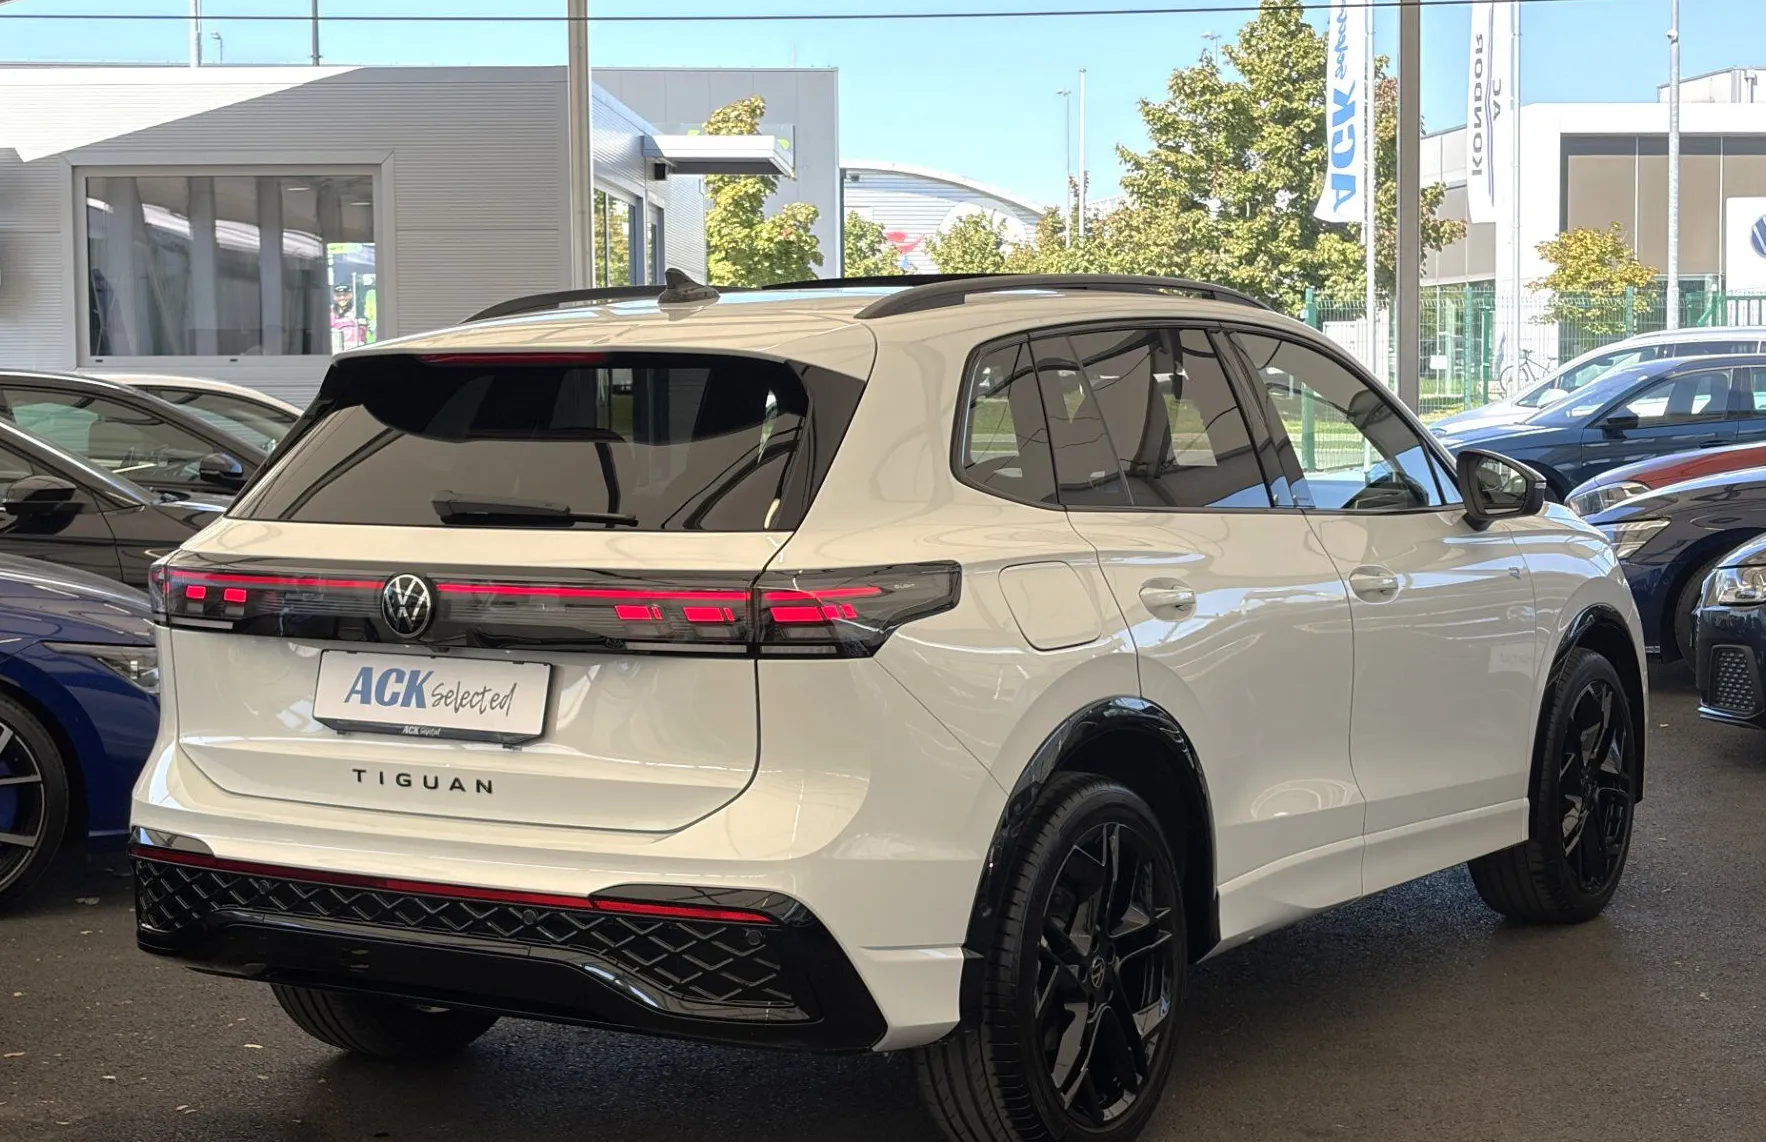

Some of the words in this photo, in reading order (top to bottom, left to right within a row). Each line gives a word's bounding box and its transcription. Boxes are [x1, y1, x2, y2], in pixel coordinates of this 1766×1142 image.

[344, 666, 434, 709] ACK
[431, 680, 517, 717] Selected
[402, 725, 420, 735] ACK
[352, 768, 494, 795] TIGUAN
